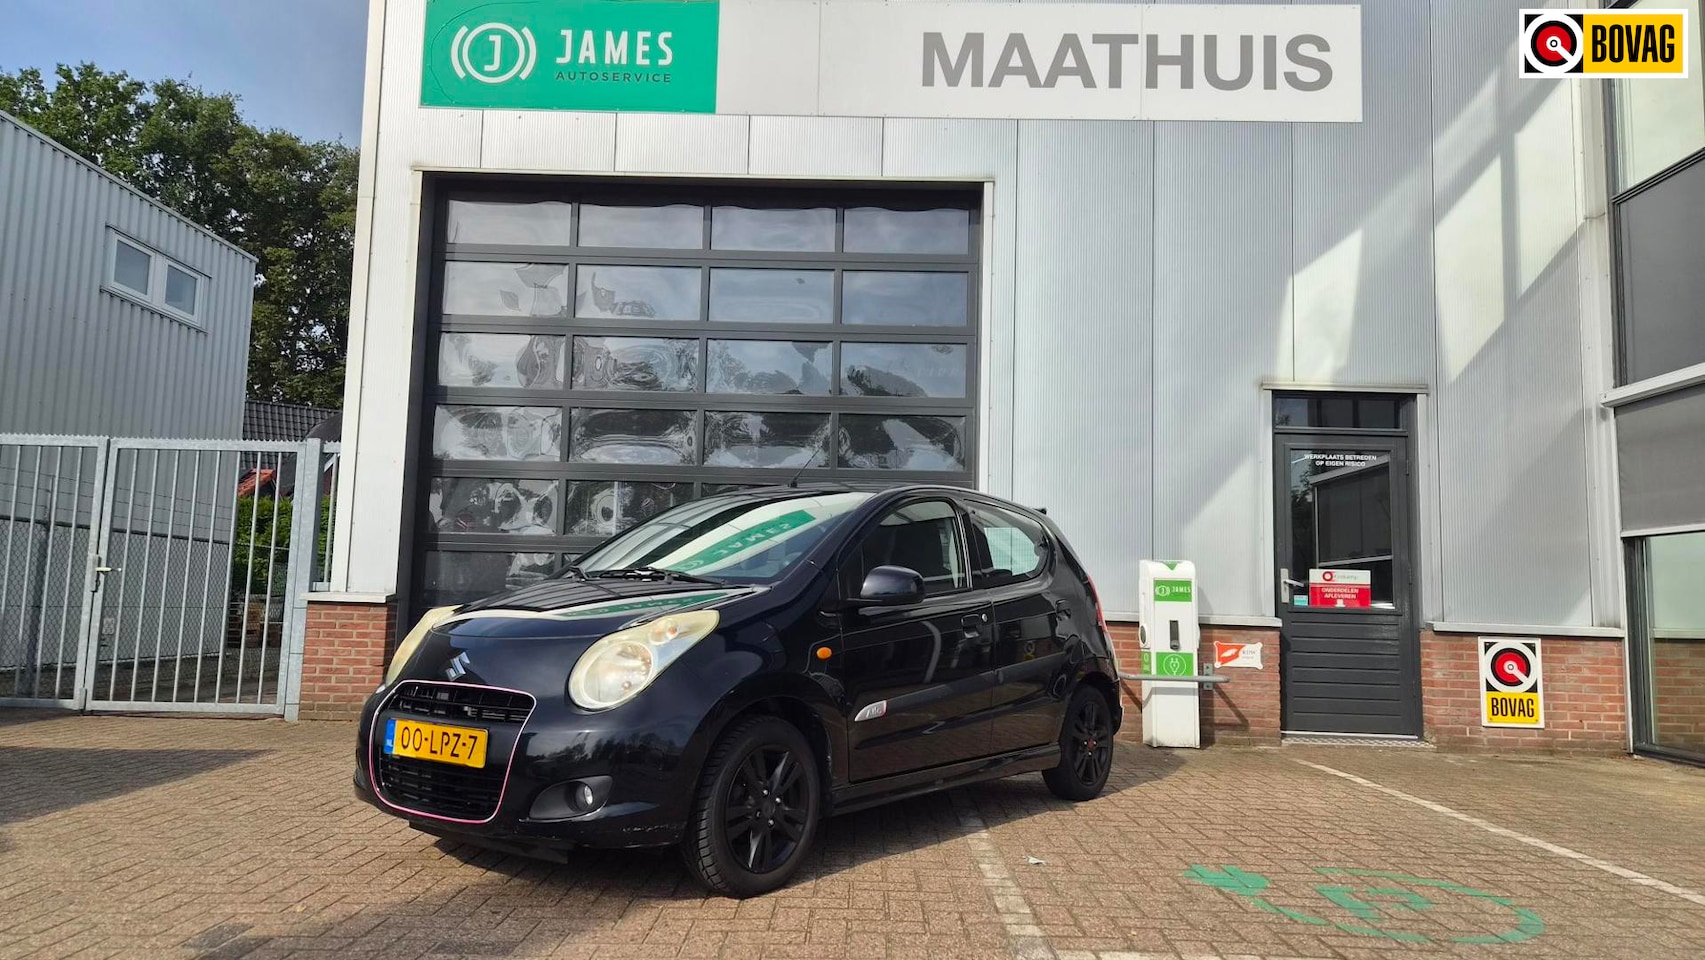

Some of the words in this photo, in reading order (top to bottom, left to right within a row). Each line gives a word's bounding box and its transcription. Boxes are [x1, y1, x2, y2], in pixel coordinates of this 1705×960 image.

[484, 35, 501, 72] J
[555, 29, 674, 66] JAMES
[921, 31, 1334, 92] MAATHUIS
[555, 71, 672, 83] AUTOSERVICE
[1321, 586, 1359, 594] ONDERDELEN
[1491, 697, 1535, 718] BOVAG
[401, 726, 478, 759] 00-LPZ-7
